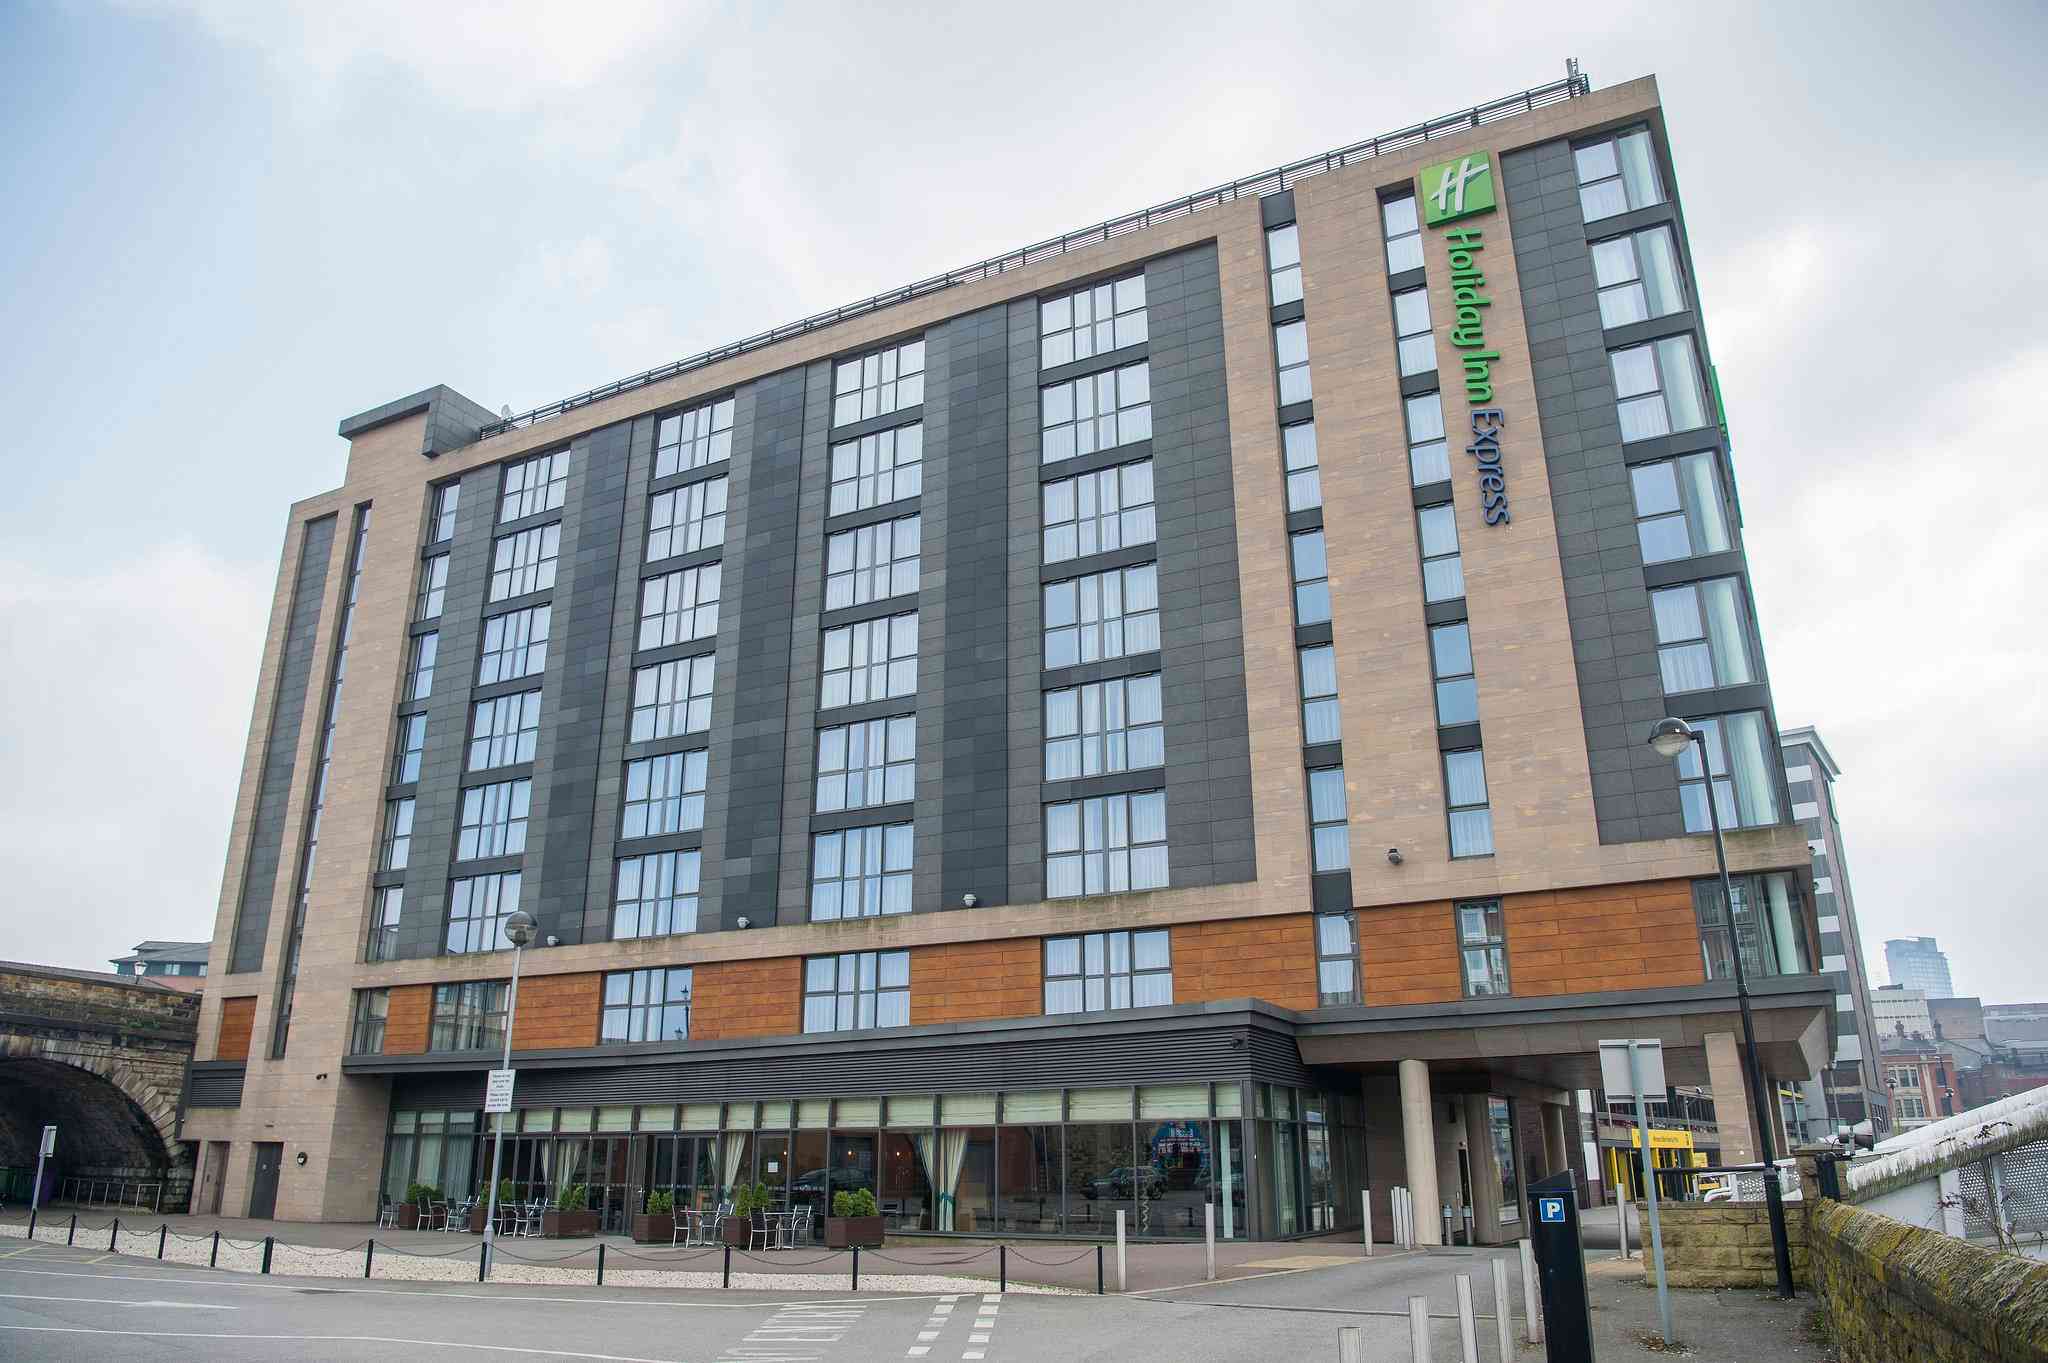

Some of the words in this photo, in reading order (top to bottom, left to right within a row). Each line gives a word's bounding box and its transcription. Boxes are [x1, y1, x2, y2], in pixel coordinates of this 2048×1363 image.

[1446, 227, 1492, 347] Holiday
[1462, 351, 1500, 404] Inn
[1466, 408, 1511, 526] Express
[1546, 1202, 1560, 1217] P
[742, 1304, 868, 1341] ENTRY
